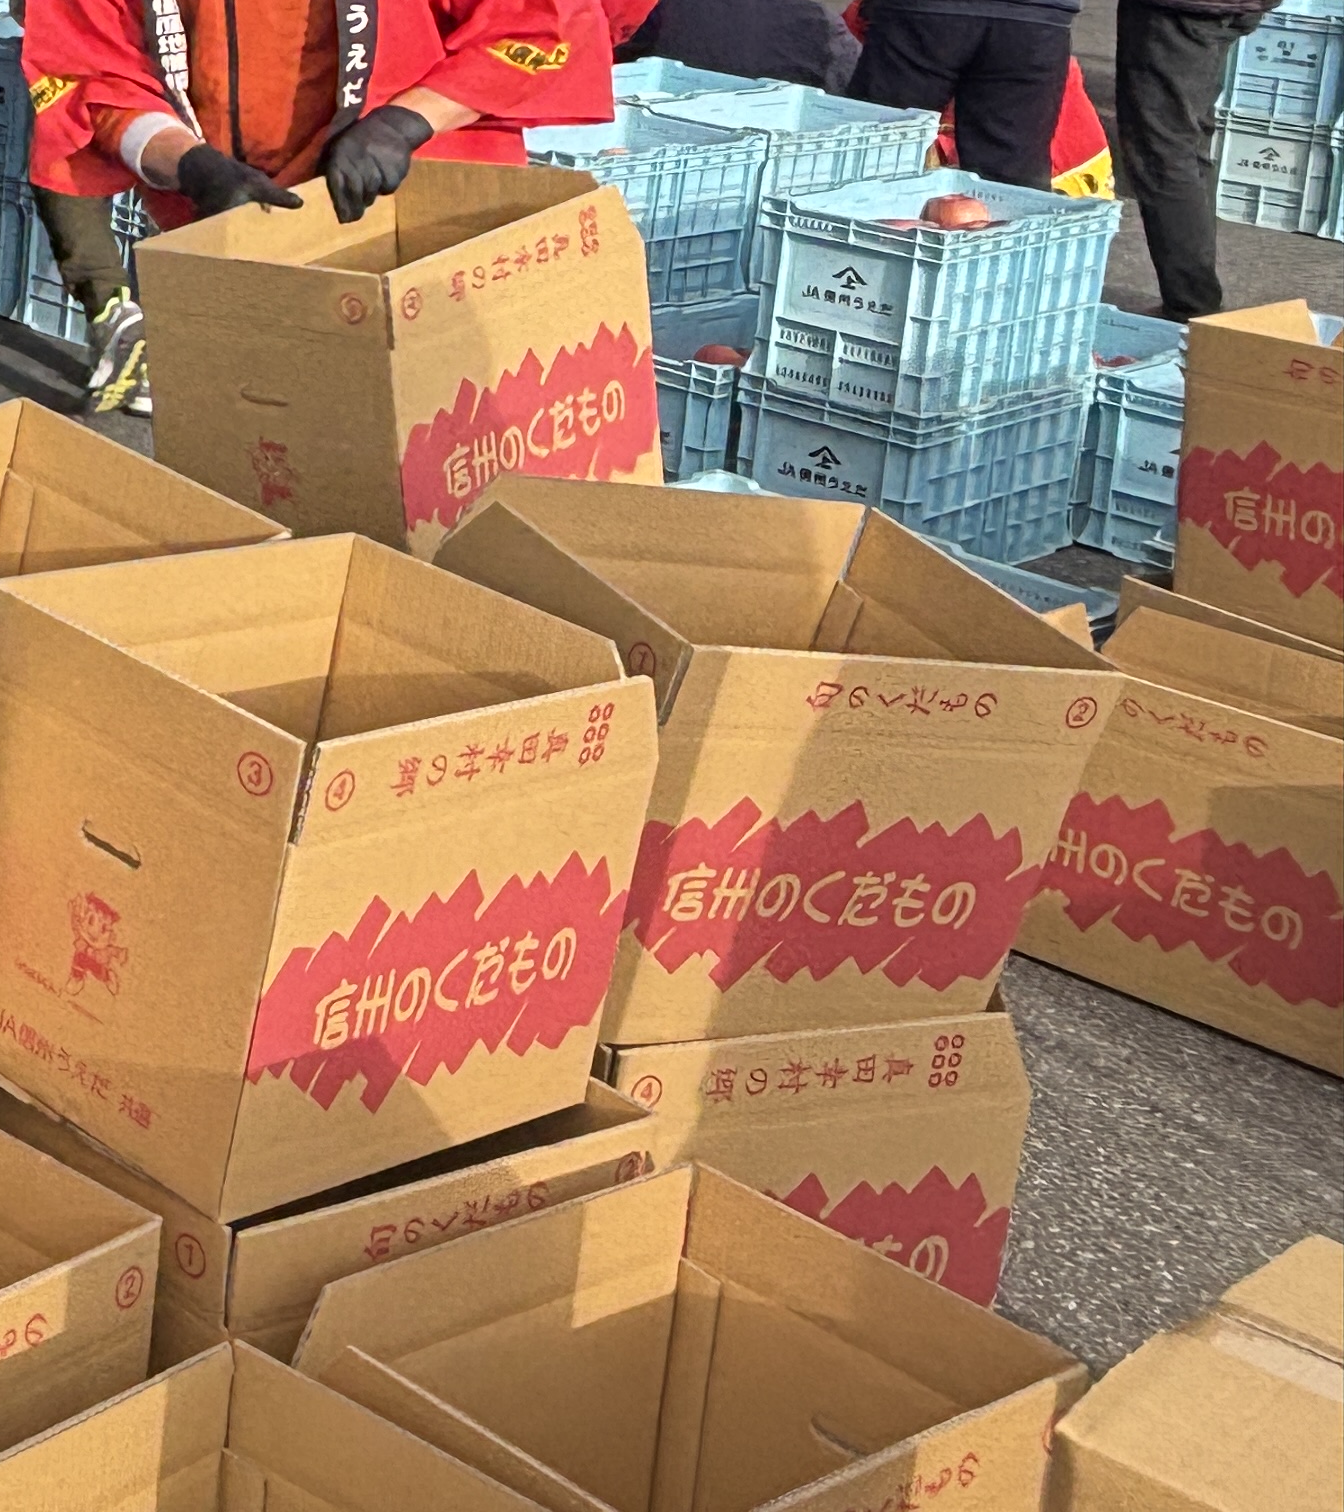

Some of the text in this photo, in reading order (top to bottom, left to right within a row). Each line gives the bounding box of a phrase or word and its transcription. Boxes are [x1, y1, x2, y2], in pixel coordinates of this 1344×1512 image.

[443, 379, 626, 499] 信州のくだもの
[1223, 486, 1336, 551] 信州の
[663, 862, 977, 930] 信州のくだもの
[313, 926, 578, 1051] 信州のくだもの
